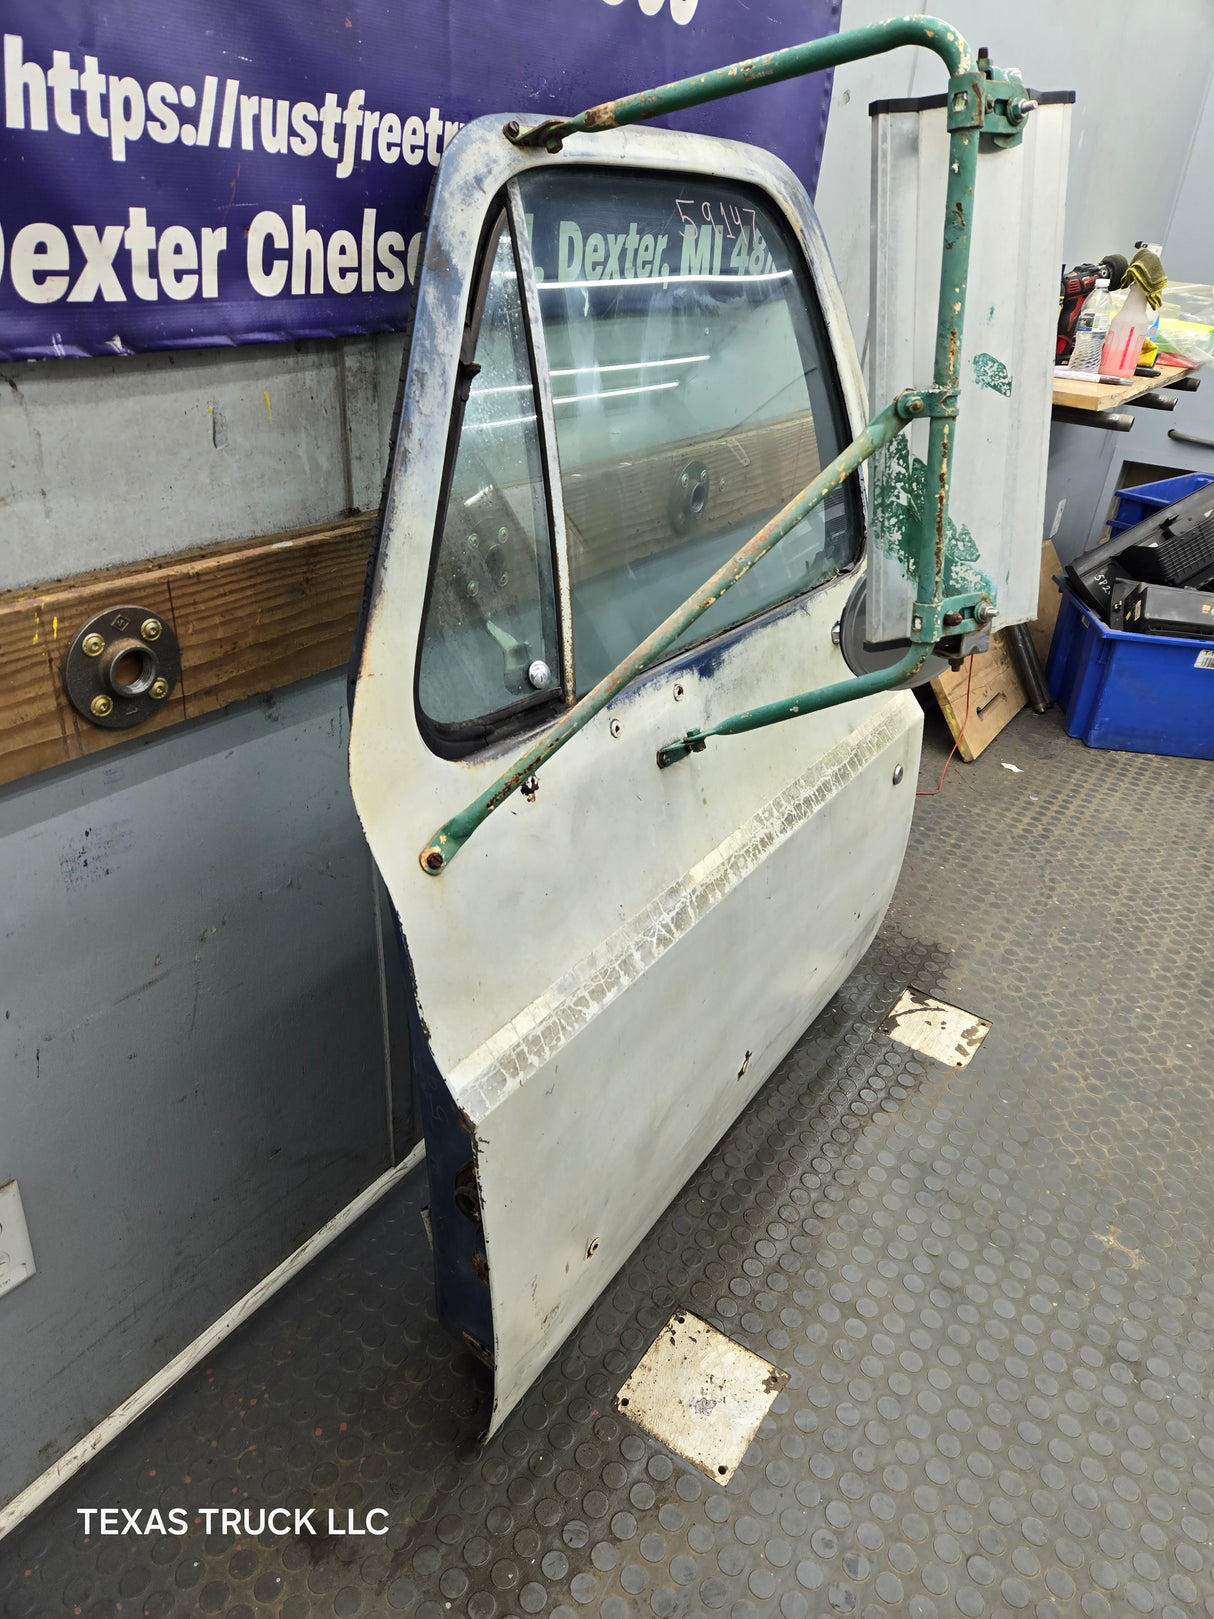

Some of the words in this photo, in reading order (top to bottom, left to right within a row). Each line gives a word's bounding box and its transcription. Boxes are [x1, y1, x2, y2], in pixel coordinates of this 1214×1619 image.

[4, 33, 465, 178] https://rustfreetr
[0, 207, 227, 303] exter
[557, 220, 669, 290] Dexter,
[680, 224, 724, 277] MI
[730, 225, 778, 277] 48
[676, 199, 757, 245] 59147
